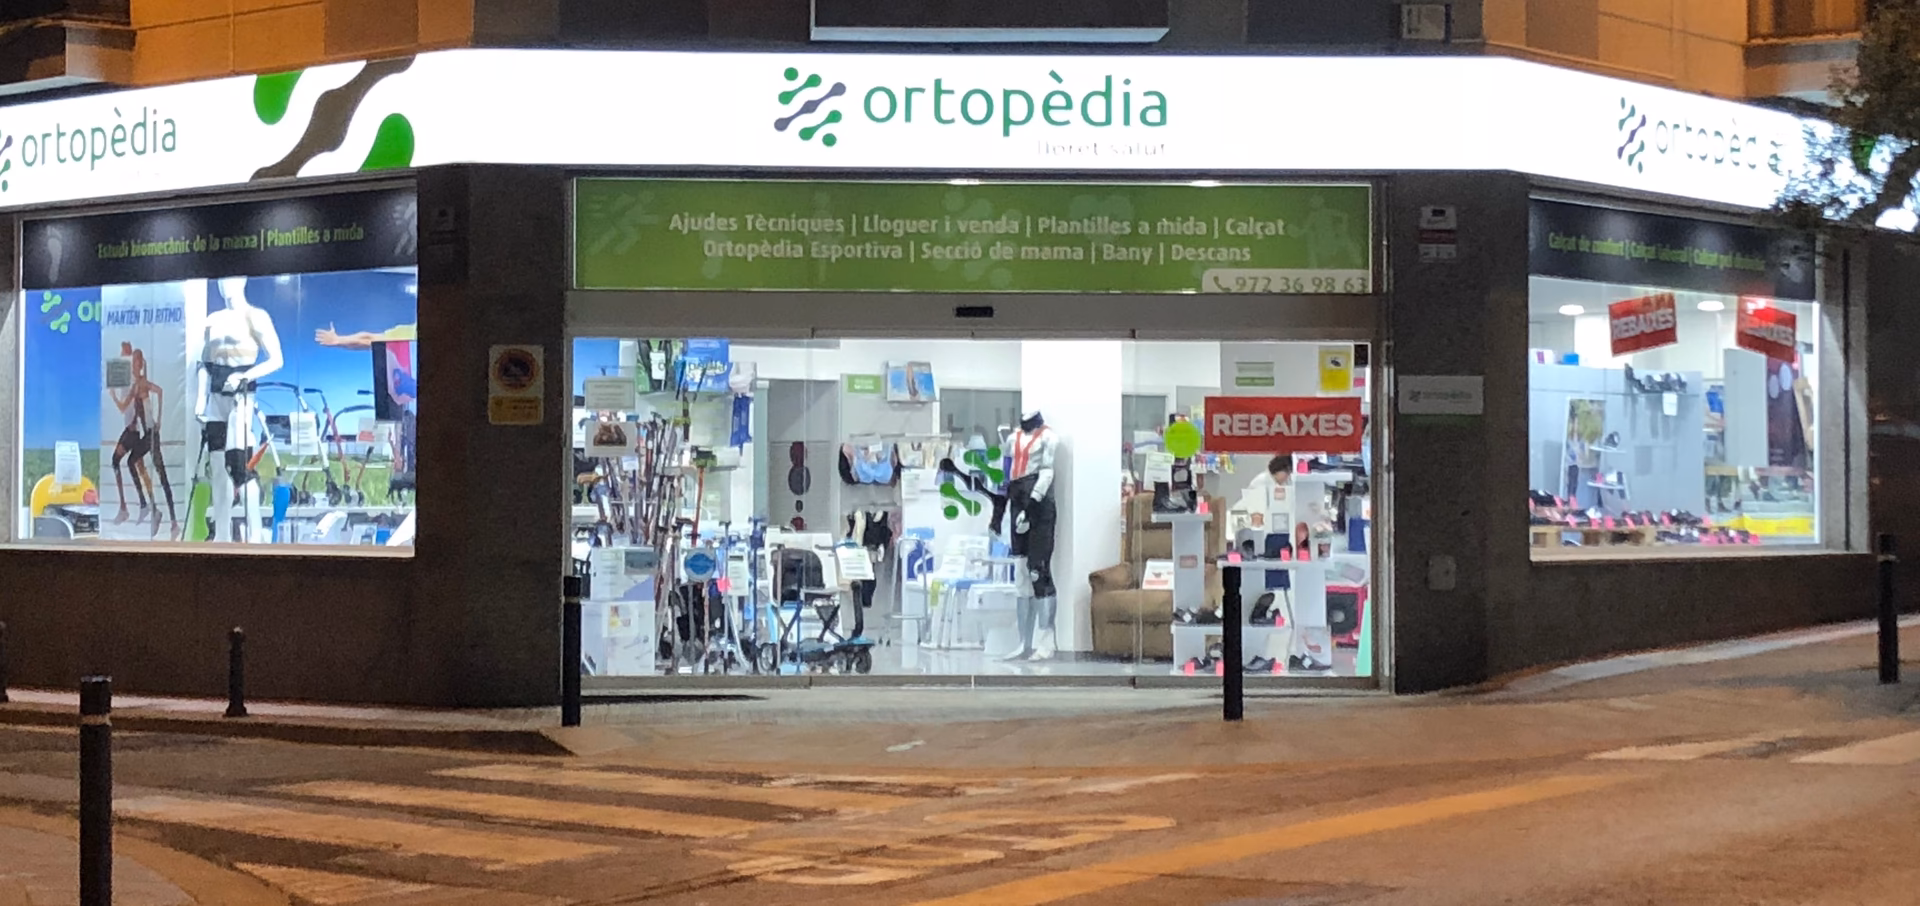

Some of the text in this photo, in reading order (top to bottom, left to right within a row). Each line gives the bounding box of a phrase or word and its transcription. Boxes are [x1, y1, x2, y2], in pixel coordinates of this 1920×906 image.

[863, 69, 1168, 137] ortopèdia
[22, 106, 176, 171] ortopèdia
[267, 226, 320, 247] Plantilles
[669, 212, 1286, 240] Ajudes Tècniques Lloguer i venda Plantilles a mida Calçat
[703, 240, 1252, 264] Ortopèdia Esportiva Secció de mama Bany Descans
[1235, 276, 1369, 293] 972 36 98 63
[107, 306, 182, 326] MANTÉN TU RITMO
[1612, 308, 1676, 340] REBAIXES
[1212, 413, 1355, 437] REBAIXES
